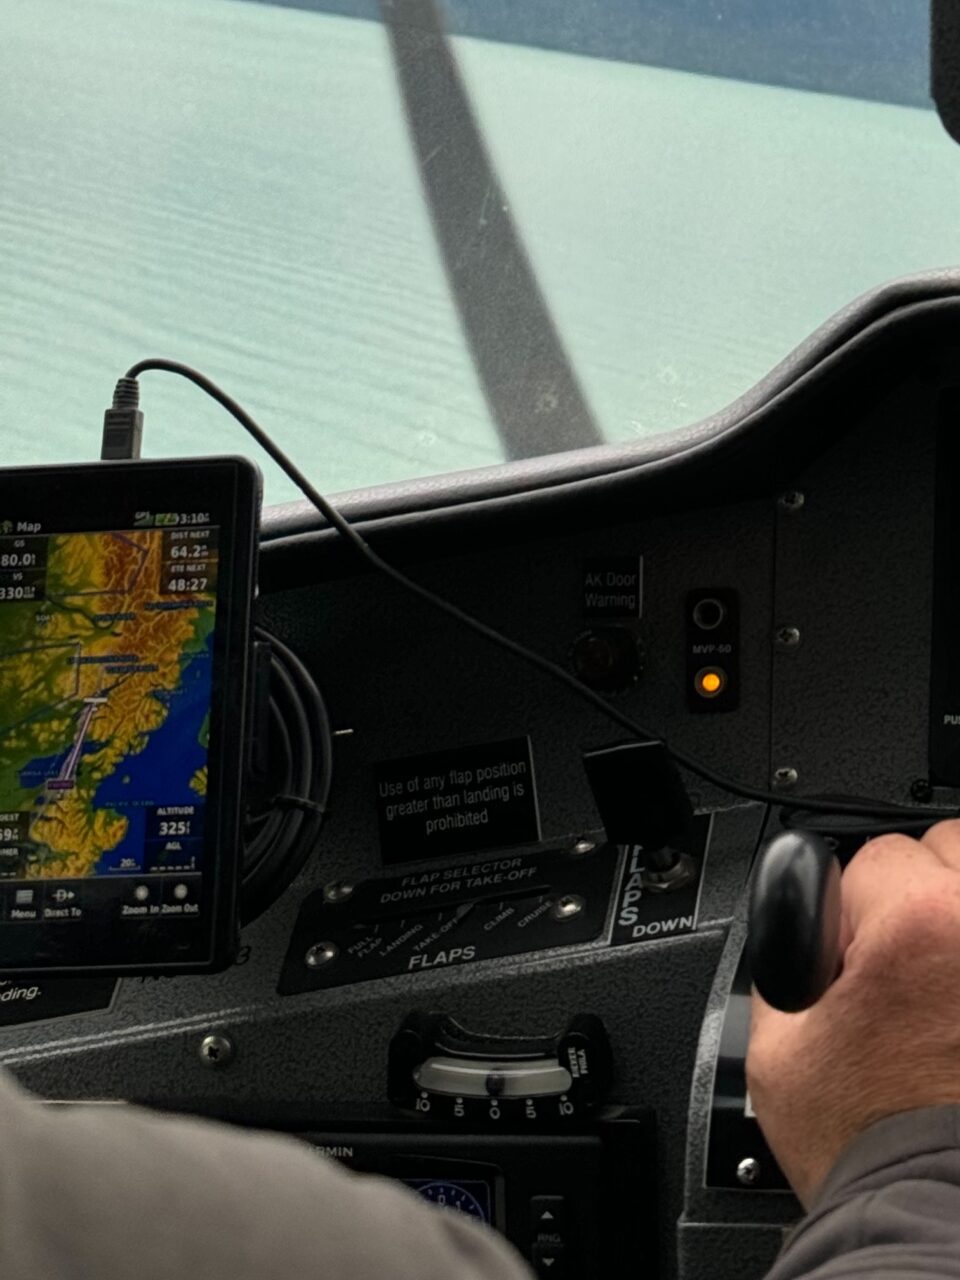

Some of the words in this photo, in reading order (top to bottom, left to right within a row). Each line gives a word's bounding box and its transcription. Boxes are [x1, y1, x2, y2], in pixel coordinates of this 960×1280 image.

[16, 521, 42, 533] Map
[190, 529, 210, 538] NEXT
[170, 544, 201, 558] 64.2
[168, 577, 208, 592] 48:27
[584, 572, 602, 588] AK
[606, 571, 637, 587] Door
[584, 592, 637, 611] Warning
[378, 780, 404, 799] Use
[406, 775, 421, 794] of
[423, 773, 447, 792] any
[448, 769, 474, 787] flap
[476, 760, 527, 783] position
[385, 797, 430, 822] greater
[432, 792, 462, 811] than
[463, 785, 511, 806] landing
[512, 780, 526, 798] is
[156, 806, 195, 816] ALTITUDE
[158, 821, 186, 836] 325
[425, 806, 490, 837] prohibited
[401, 870, 442, 888] FLAP
[443, 856, 524, 881] SELECTOR
[379, 886, 428, 905] DOWN
[429, 879, 463, 897] FOR
[465, 866, 539, 890] TAKE-OFF
[11, 909, 37, 919] Menu
[44, 907, 69, 919] Direct
[71, 907, 82, 918] To
[122, 905, 147, 916] Zoom
[149, 904, 160, 914] In
[161, 903, 182, 915] Zoom
[183, 903, 199, 913] Out
[516, 899, 555, 930] CRUISE
[631, 914, 693, 939] DOWN
[379, 923, 426, 958] LANDING
[406, 945, 477, 971] FLAPS
[0, 984, 42, 1002] ding.
[415, 1097, 431, 1113] 10
[454, 1103, 465, 1118] 5
[488, 1106, 501, 1119] 0
[525, 1105, 537, 1119] 5
[557, 1101, 574, 1116] 10
[314, 1146, 354, 1159] RMIN
